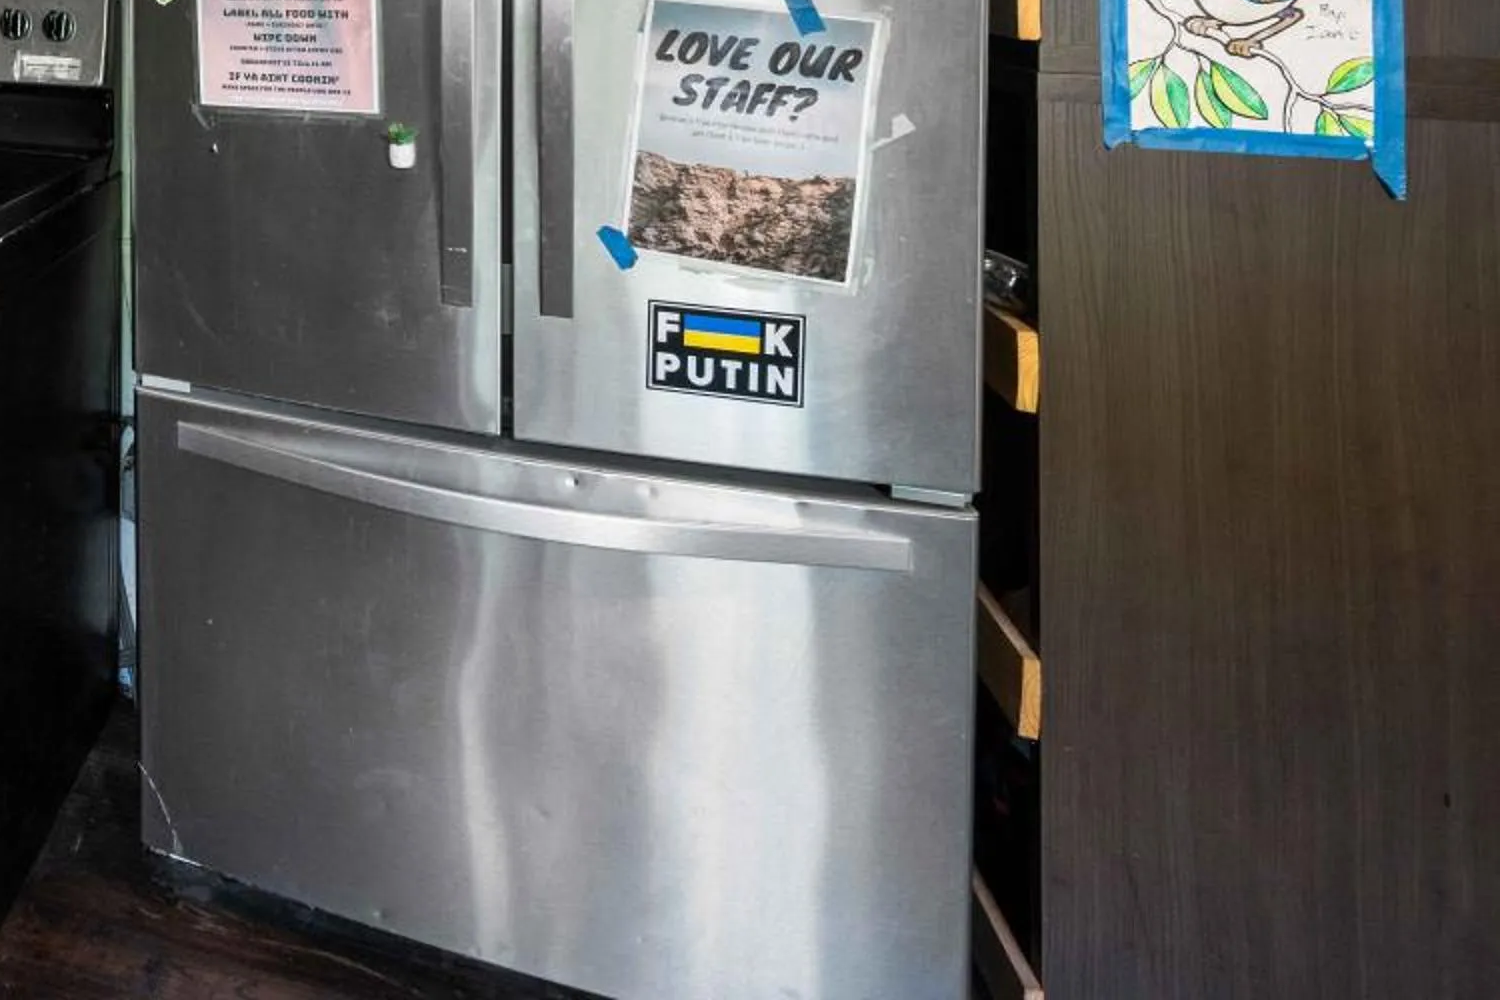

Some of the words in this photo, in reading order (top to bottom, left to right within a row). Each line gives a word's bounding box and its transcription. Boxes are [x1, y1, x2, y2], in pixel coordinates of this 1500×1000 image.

[223, 8, 258, 18] LABEL
[261, 8, 283, 18] ALL
[285, 9, 315, 19] FOOD
[317, 10, 349, 20] WITH
[253, 33, 282, 42] WIPE
[285, 33, 317, 43] DOWN
[655, 28, 760, 72] LOVE
[768, 40, 863, 84] OUR
[228, 72, 241, 81] IF
[243, 72, 258, 81] YA
[671, 73, 820, 122] STAFF?
[654, 351, 794, 398] PUTIN
